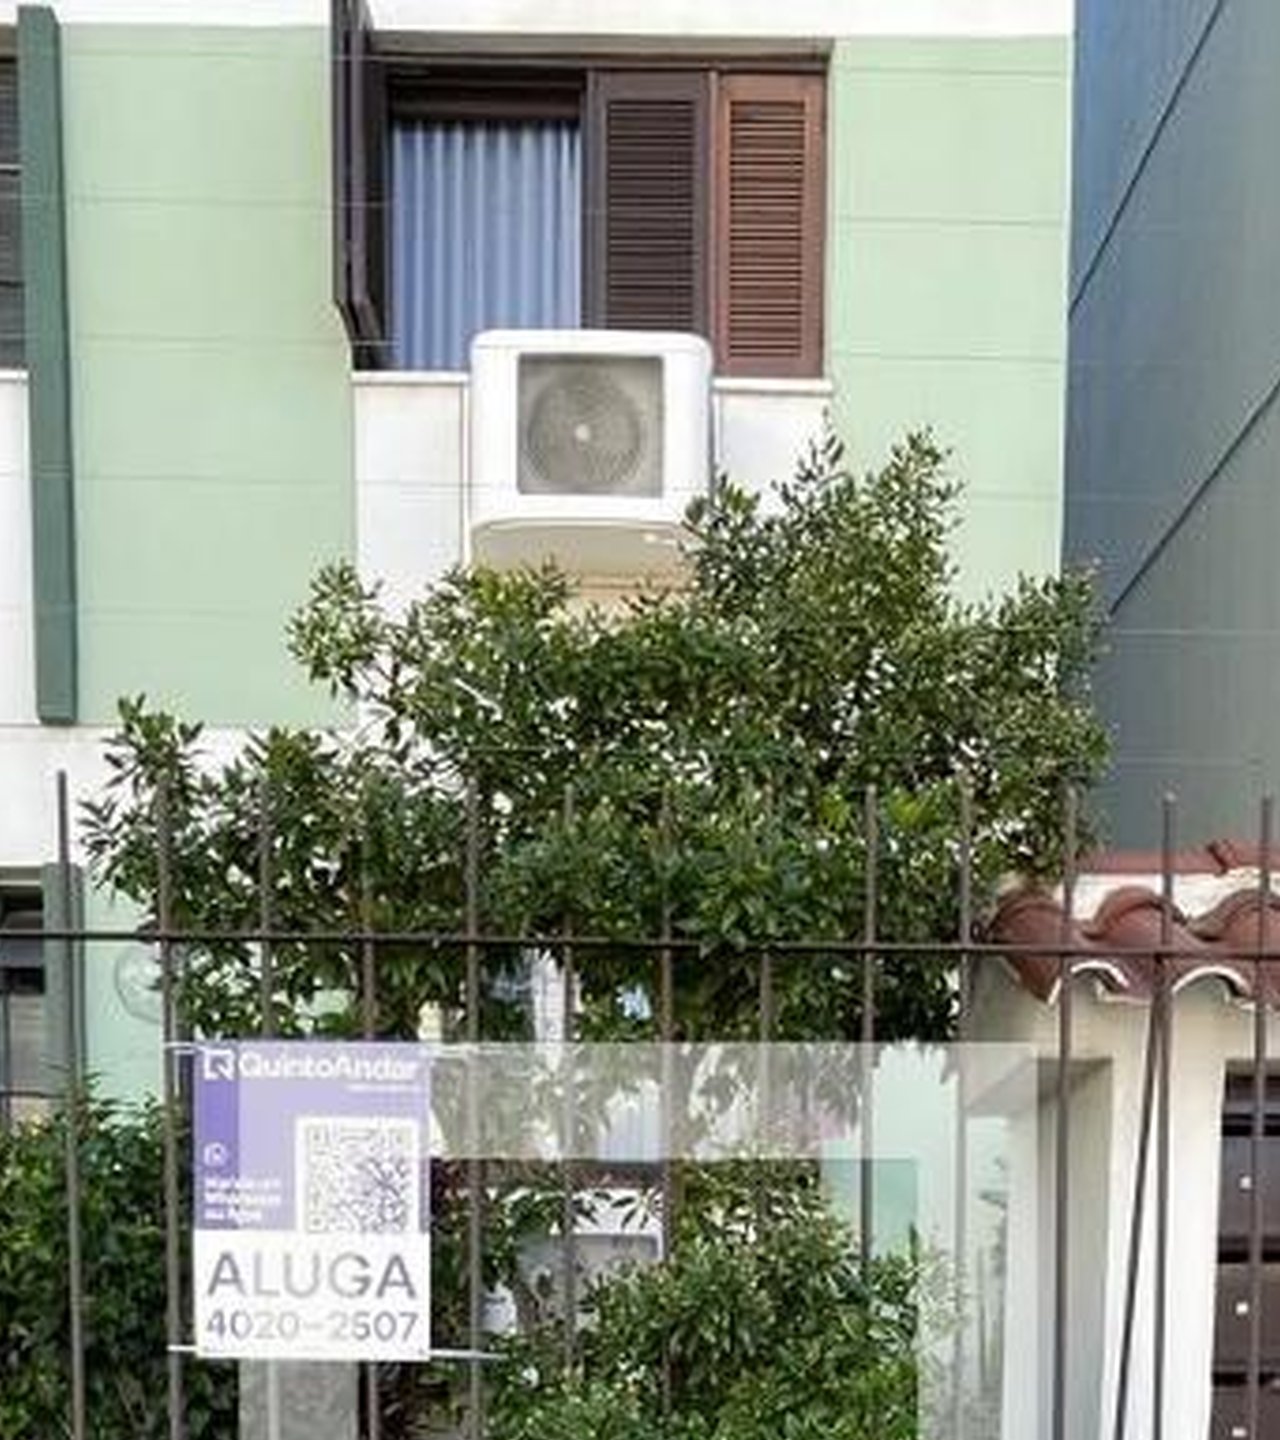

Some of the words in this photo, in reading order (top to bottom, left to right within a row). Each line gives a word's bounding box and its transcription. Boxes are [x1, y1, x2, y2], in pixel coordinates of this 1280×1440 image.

[238, 1052, 418, 1080] QuintoAndar
[207, 1251, 417, 1299] ALUGA
[206, 1310, 418, 1341] 4020-2507
